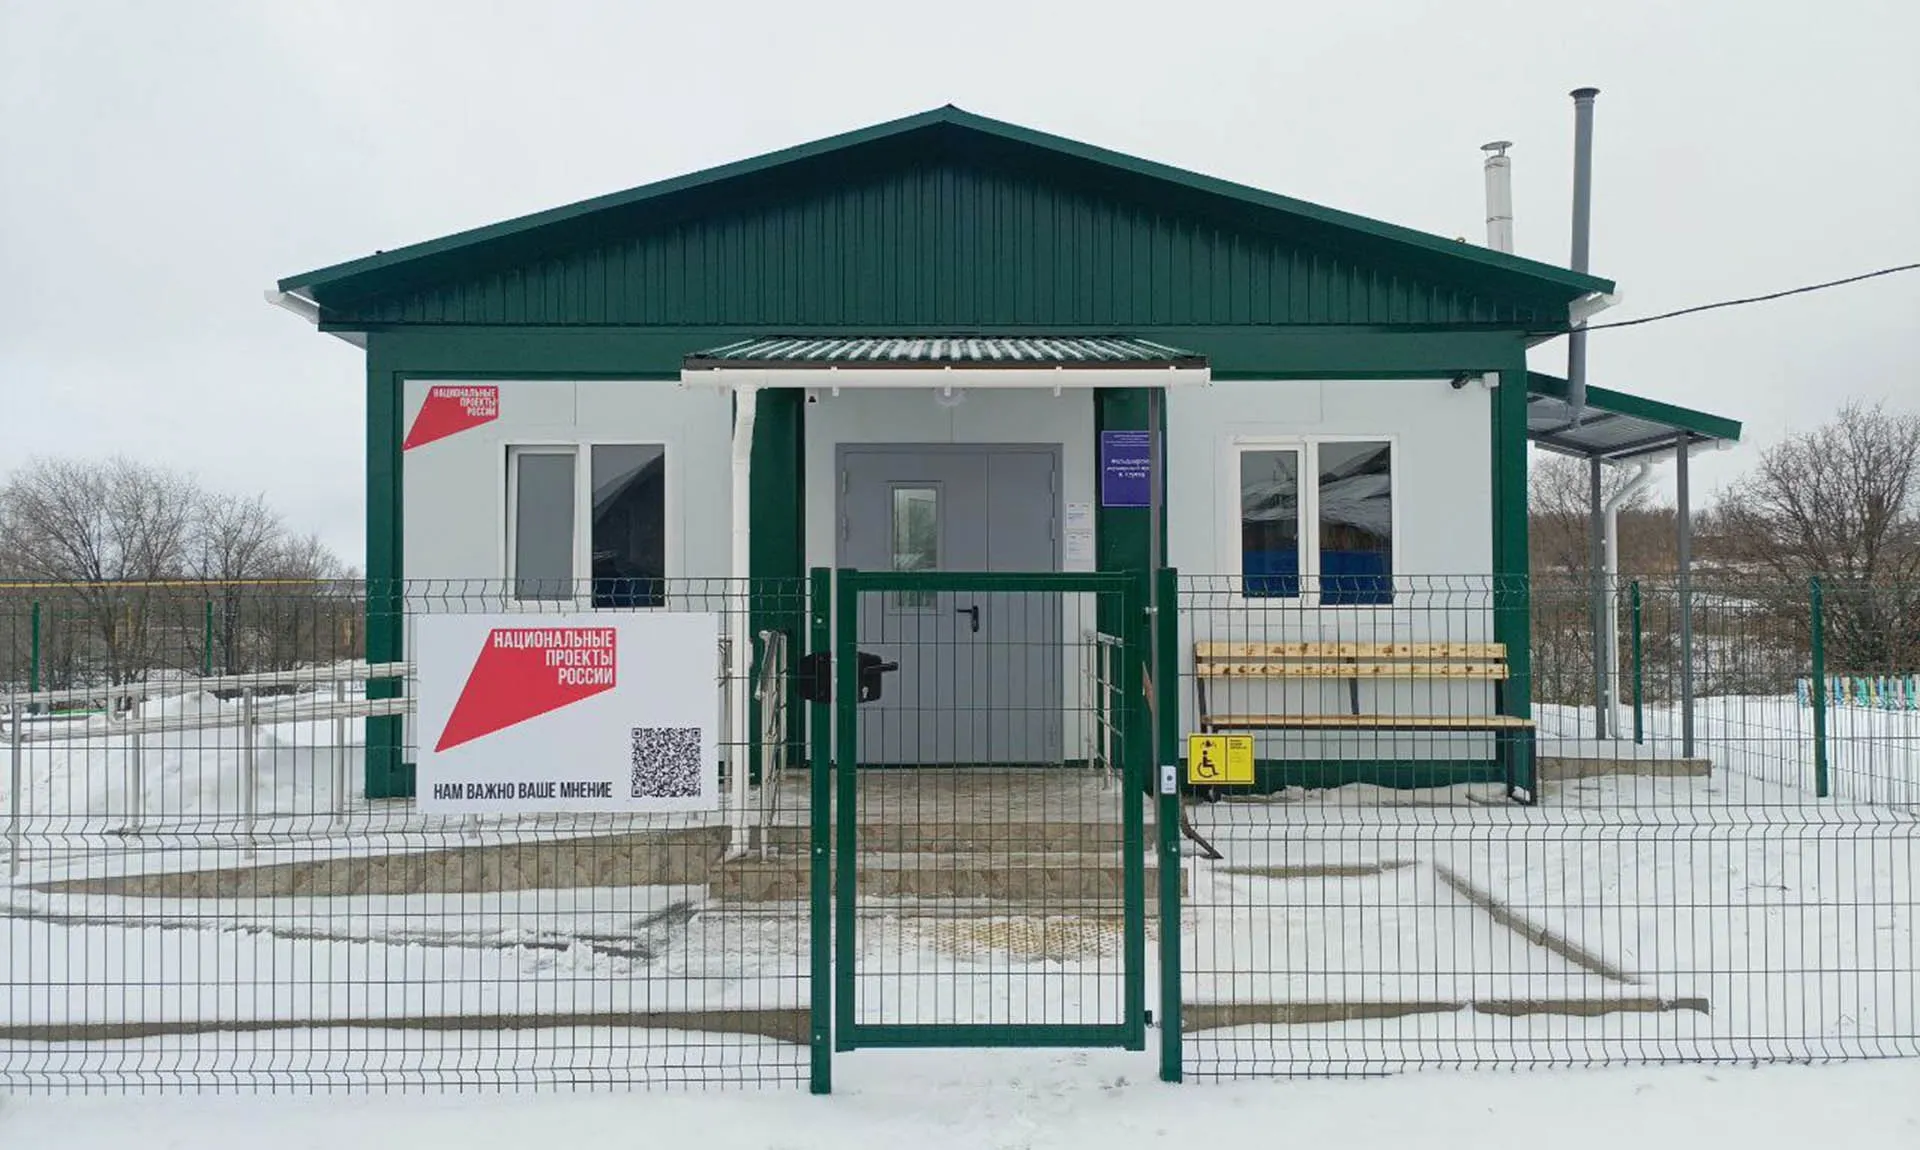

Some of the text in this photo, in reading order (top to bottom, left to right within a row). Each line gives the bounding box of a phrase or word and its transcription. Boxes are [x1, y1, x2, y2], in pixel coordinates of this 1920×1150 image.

[493, 630, 613, 650] НАЦИОНАЛЬНЫЕ
[545, 649, 613, 667] ПРОЕКТЫ
[558, 667, 614, 685] РОССИИ
[433, 781, 613, 800] НАМ ВАЖНО ВАШЕ МНЕНИЕ
